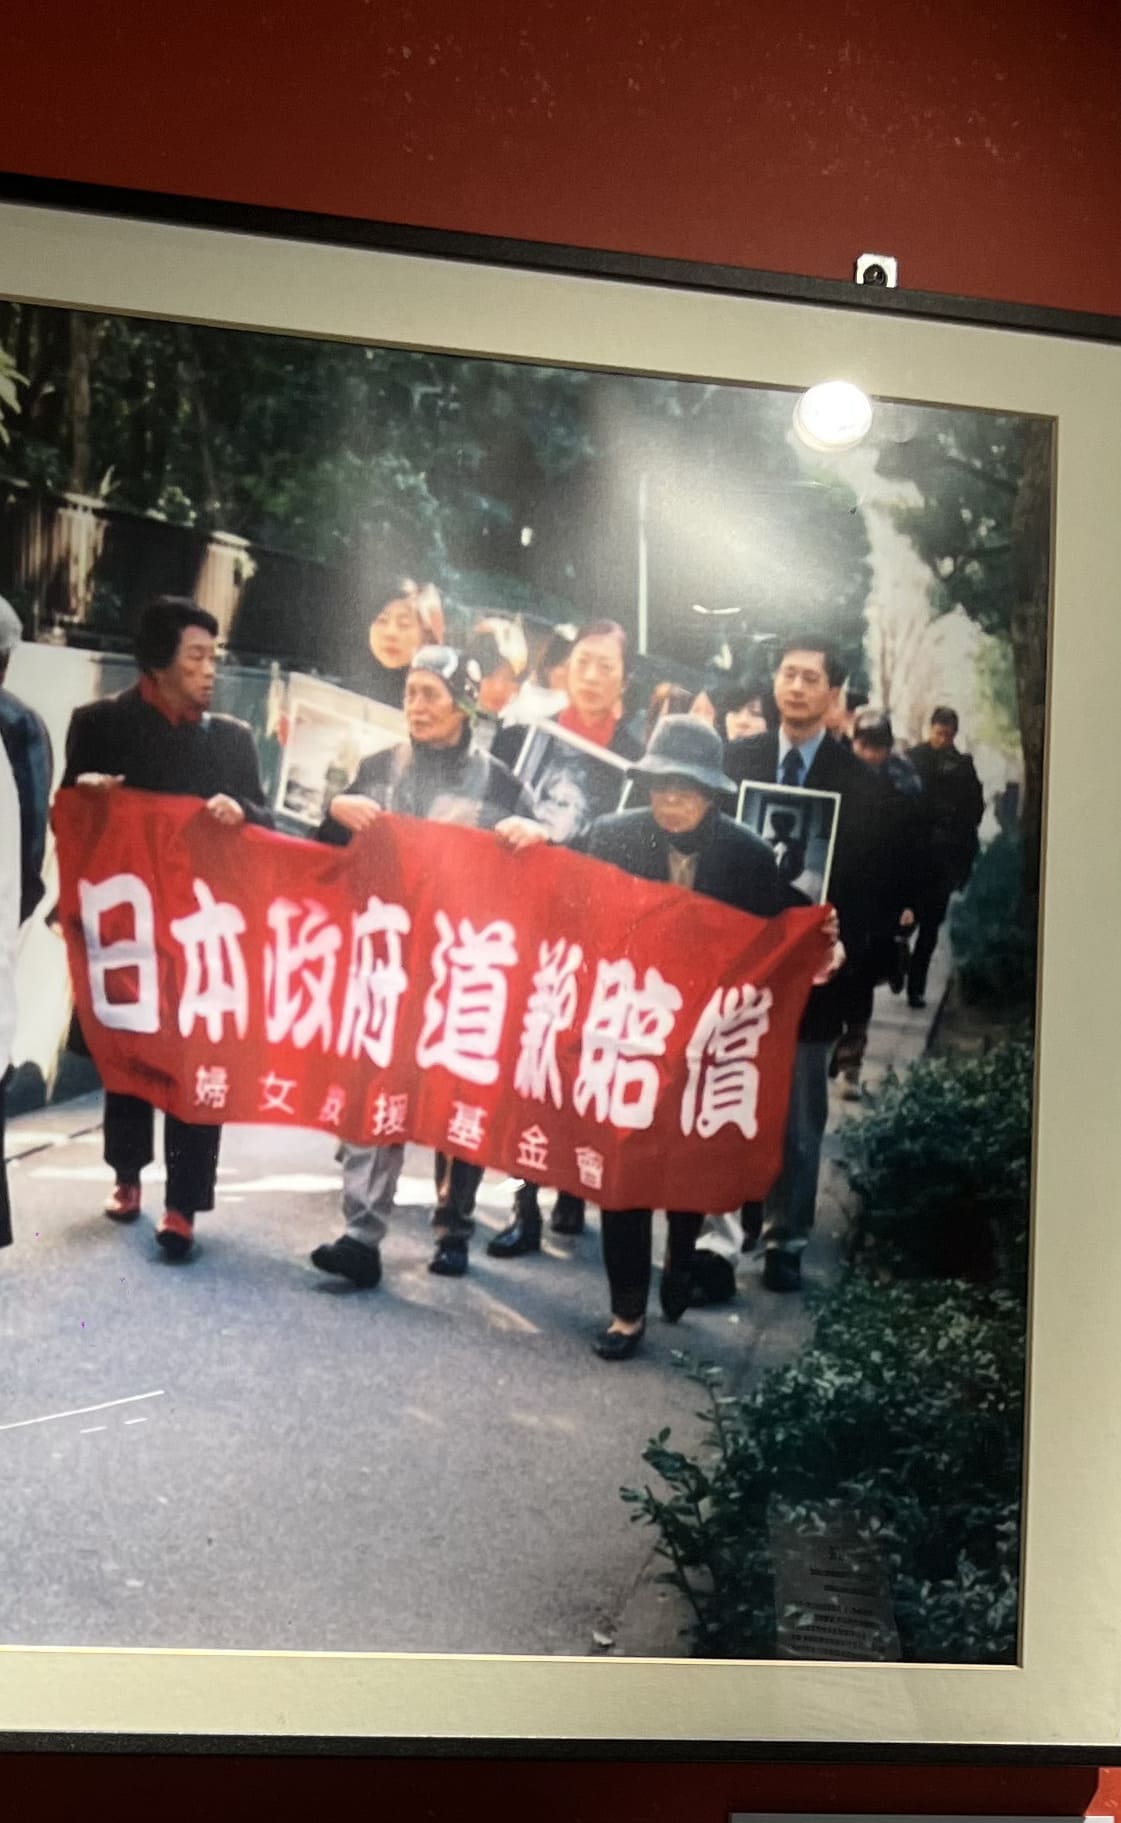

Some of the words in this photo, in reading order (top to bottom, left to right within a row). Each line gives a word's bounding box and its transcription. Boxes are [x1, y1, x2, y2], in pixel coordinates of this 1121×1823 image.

[78, 873, 773, 1140] 日本政府道歉賠償
